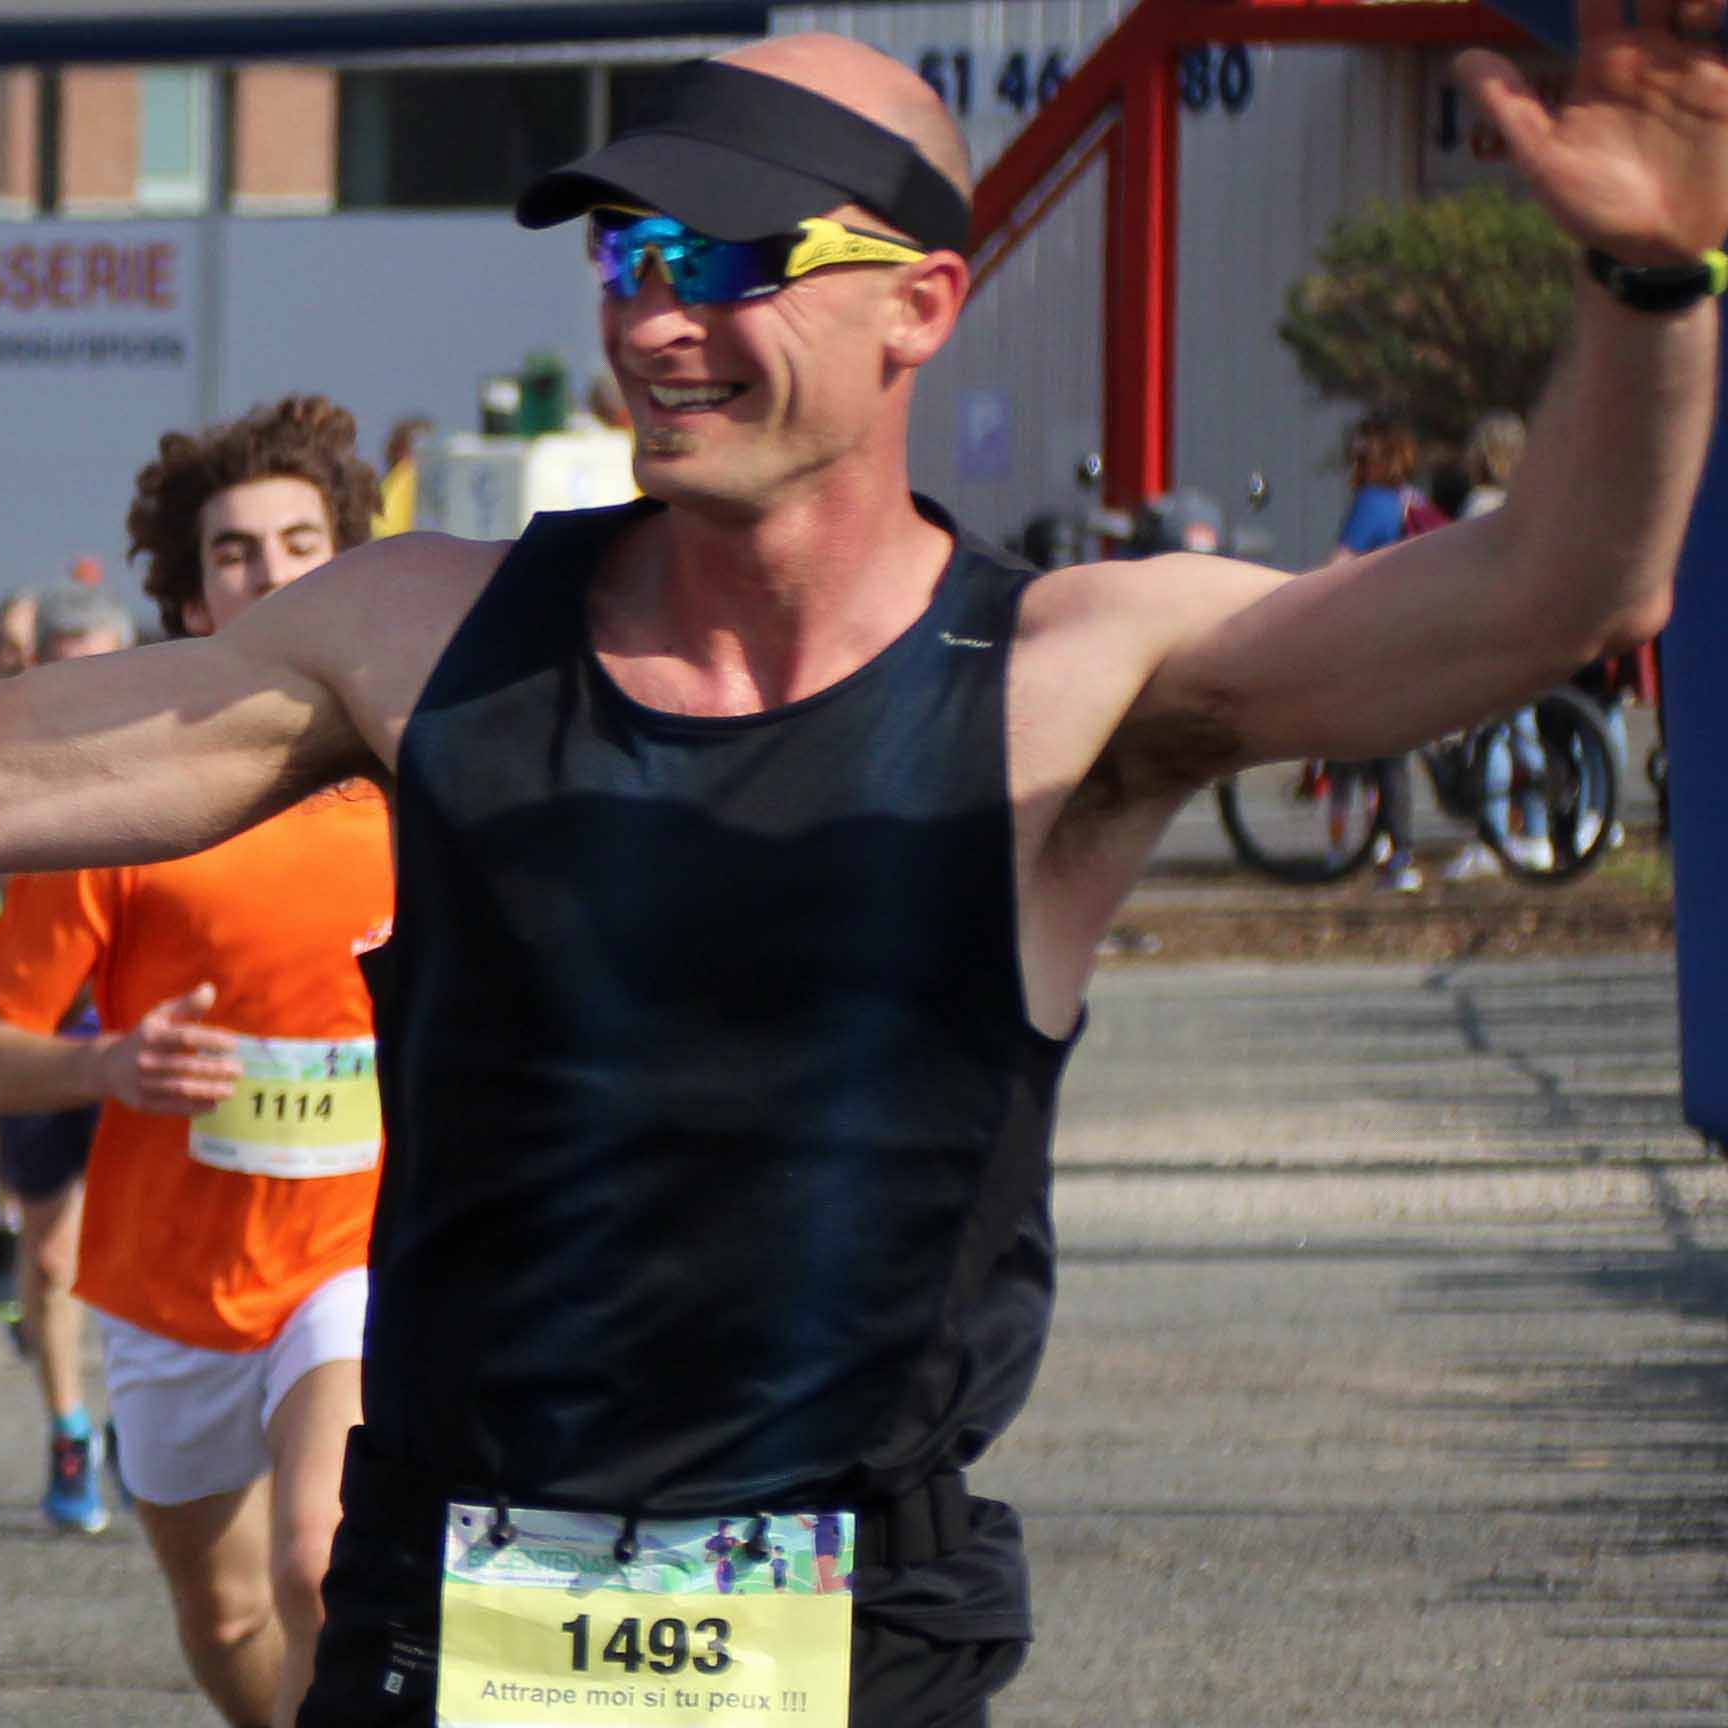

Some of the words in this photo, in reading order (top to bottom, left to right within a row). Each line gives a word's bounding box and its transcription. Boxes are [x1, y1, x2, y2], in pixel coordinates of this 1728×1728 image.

[250, 1091, 335, 1121] 1114
[561, 1613, 733, 1675] 1493
[481, 1679, 576, 1708] Attrape
[587, 1687, 634, 1707] moi
[644, 1688, 665, 1708] si
[675, 1689, 699, 1709] tu
[708, 1691, 771, 1712] peux
[781, 1692, 807, 1713] !!!
